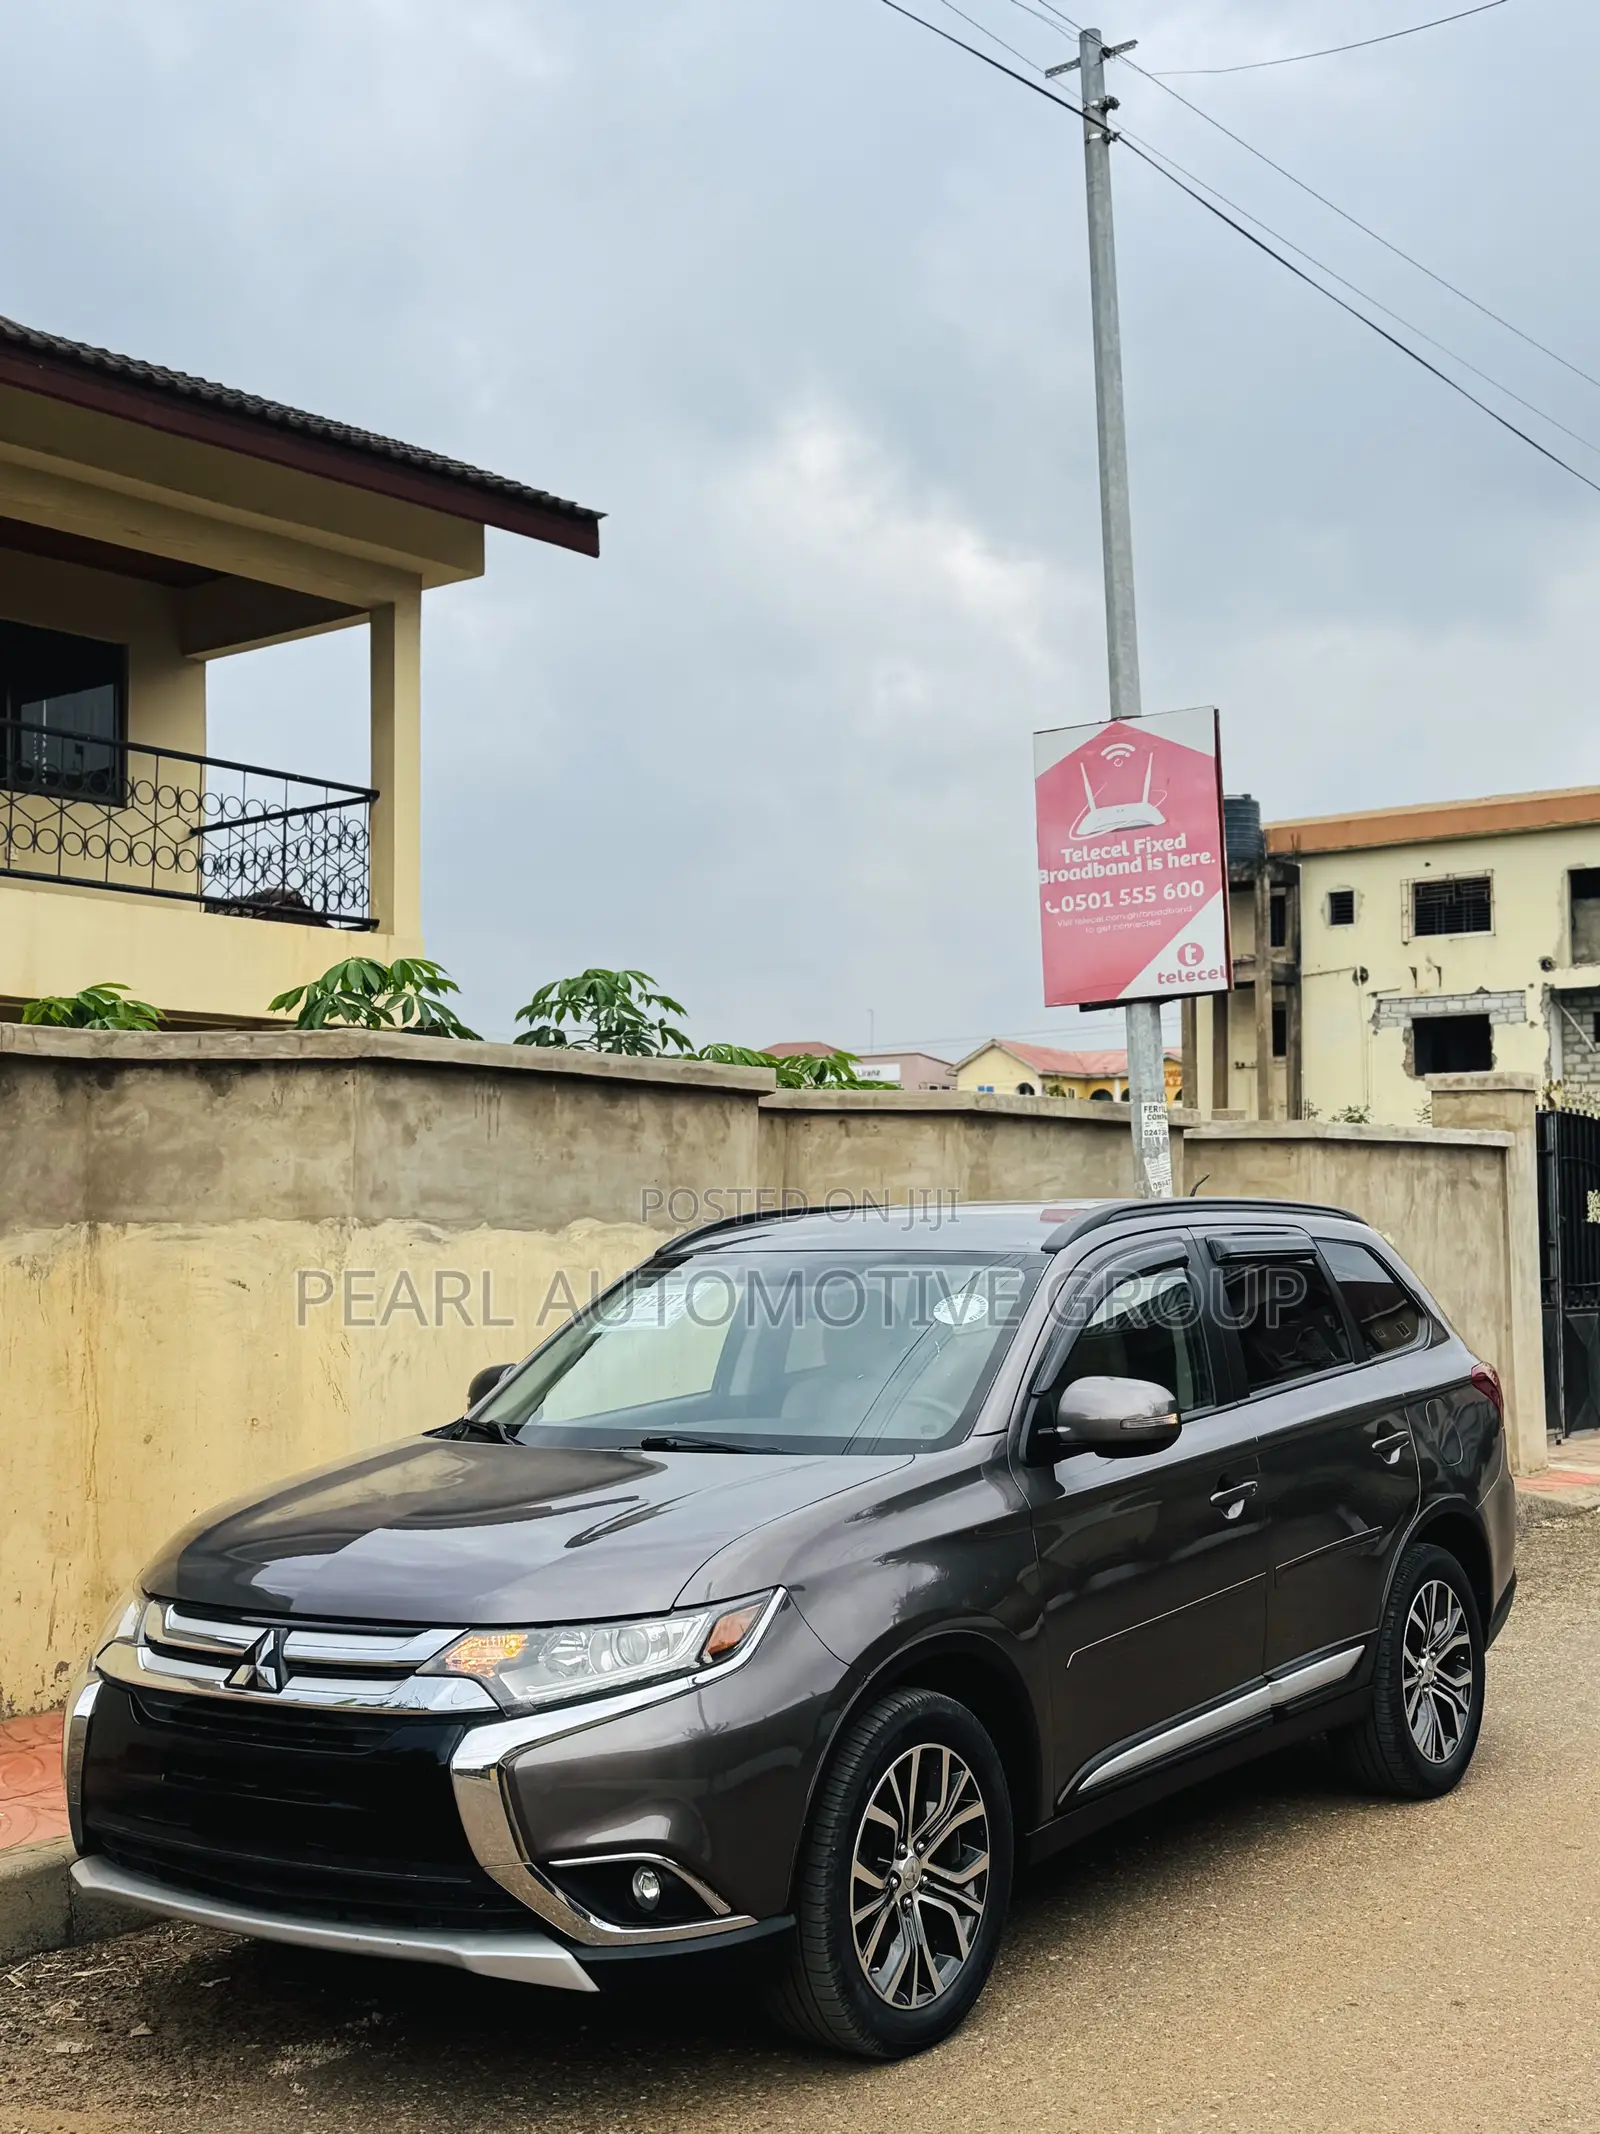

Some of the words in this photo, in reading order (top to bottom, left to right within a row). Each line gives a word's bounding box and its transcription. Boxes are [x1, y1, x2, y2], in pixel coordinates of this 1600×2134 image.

[1060, 840, 1130, 864] Telecel
[1134, 833, 1187, 855] Fixed
[1039, 856, 1142, 885] Broadband
[1147, 854, 1163, 871] is
[1167, 851, 1216, 869] here.
[1061, 891, 1113, 912] 0501
[1119, 886, 1156, 905] 555
[1163, 880, 1205, 900] 600
[1157, 964, 1227, 985] telecel
